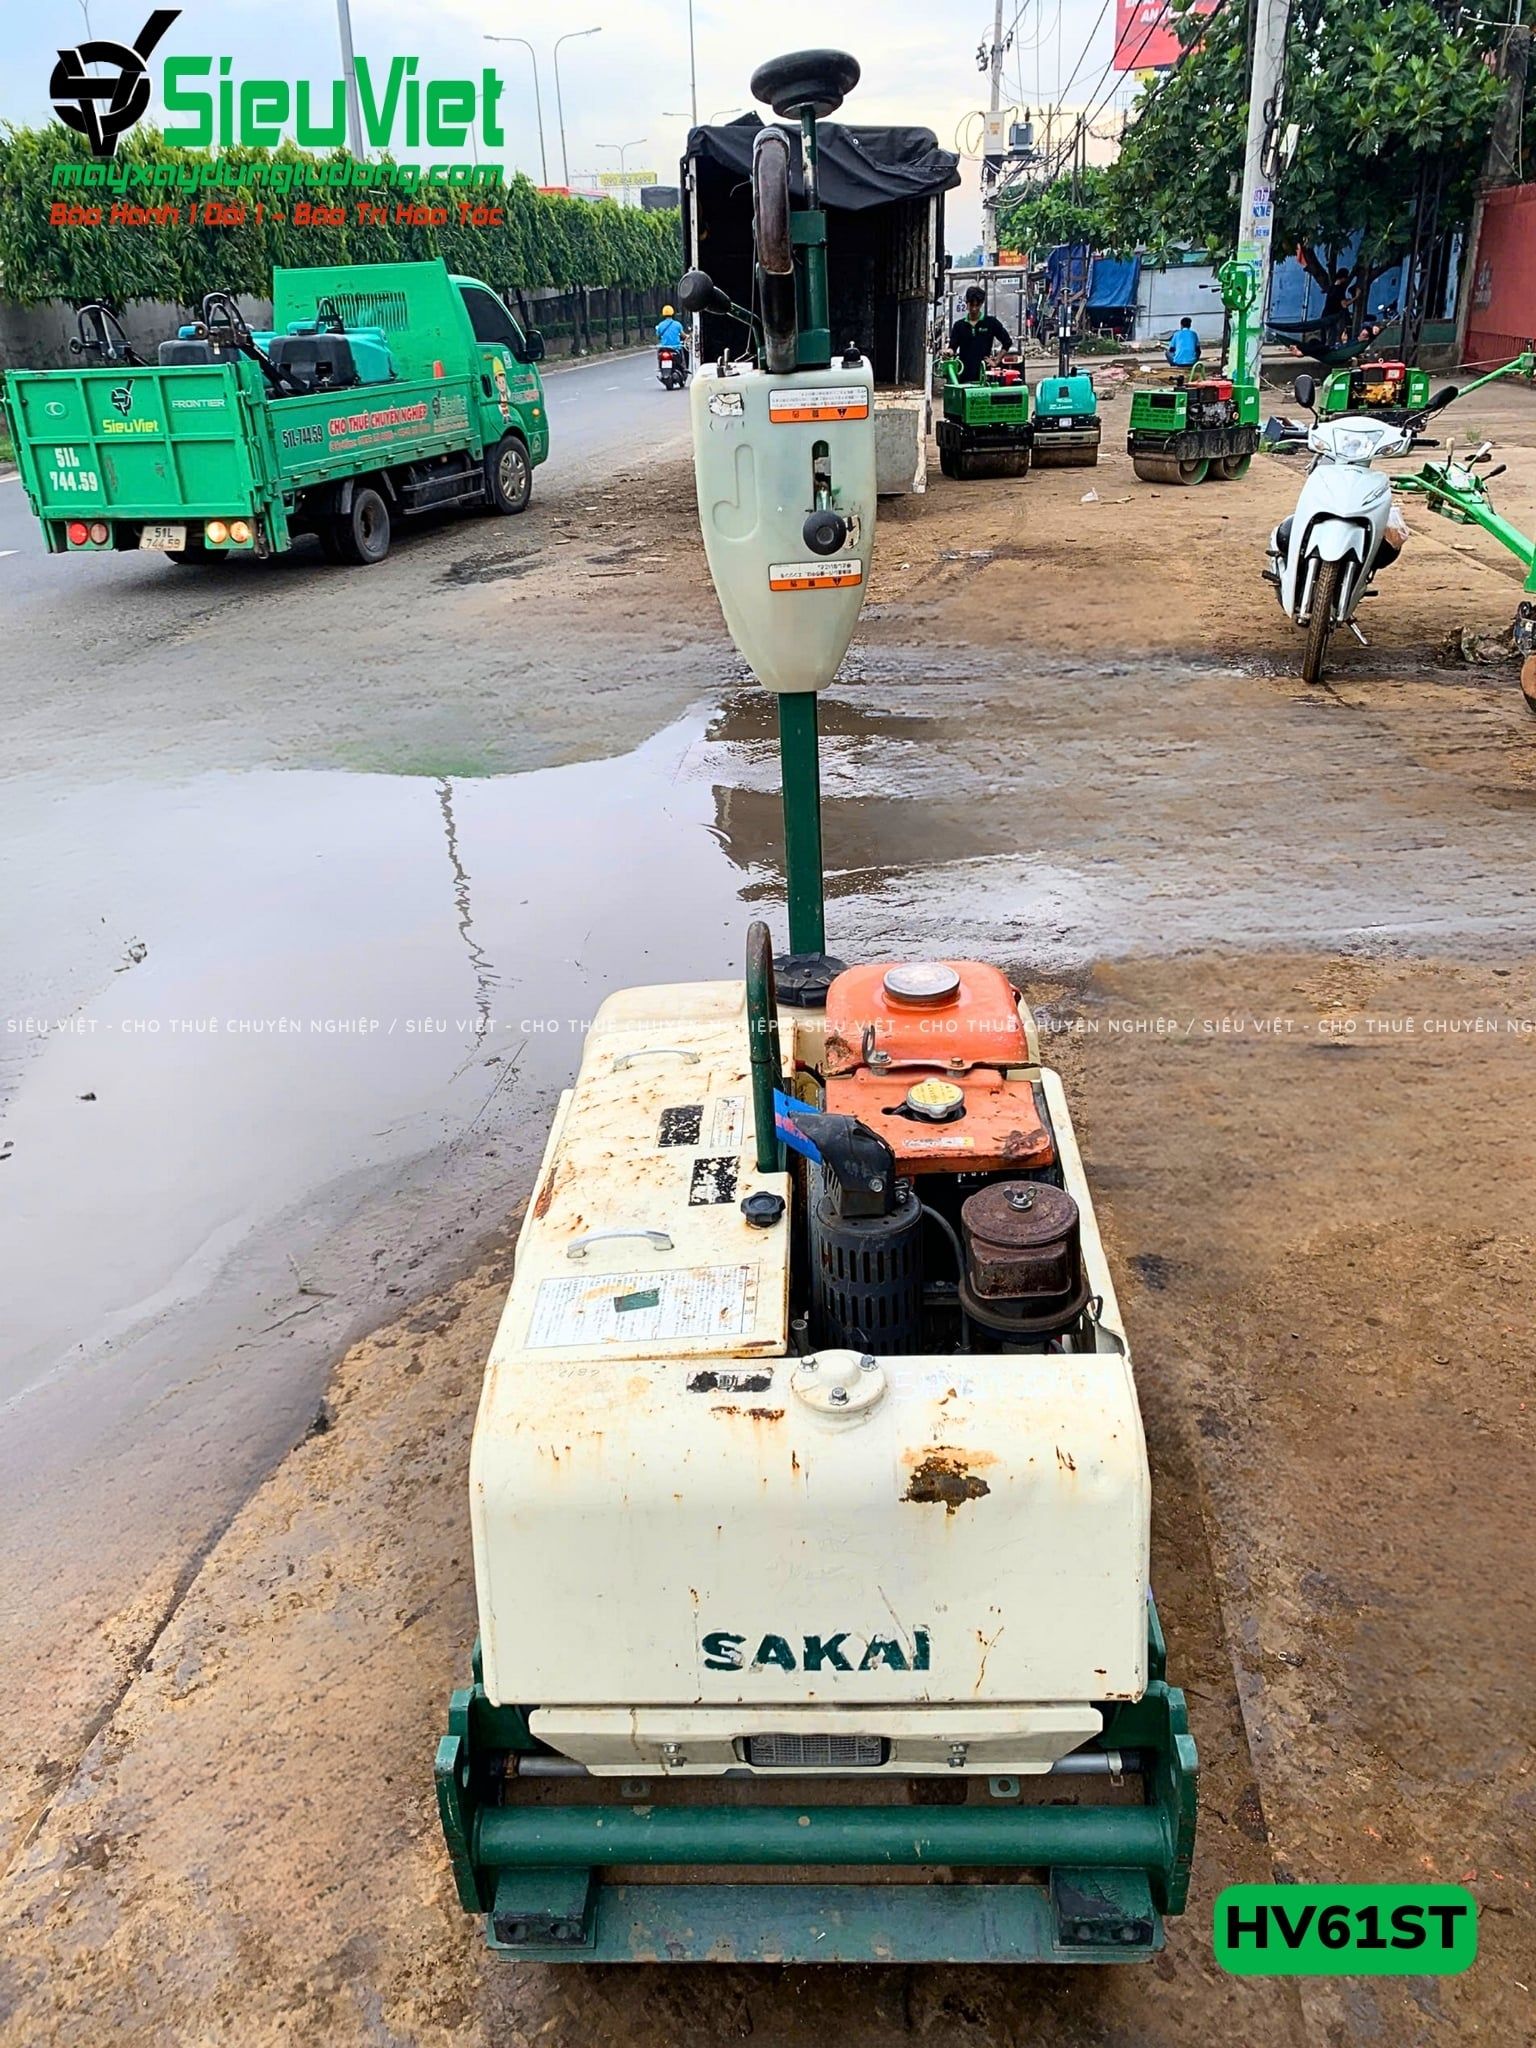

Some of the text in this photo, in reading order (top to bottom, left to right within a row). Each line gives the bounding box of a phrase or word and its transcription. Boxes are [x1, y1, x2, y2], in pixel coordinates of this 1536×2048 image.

[171, 398, 226, 409] FRONTIER
[102, 418, 159, 434] SieuViet
[54, 447, 80, 468] 51L
[49, 471, 98, 492] 744.59
[154, 527, 173, 538] 51L
[701, 1625, 931, 1672] SAKAI
